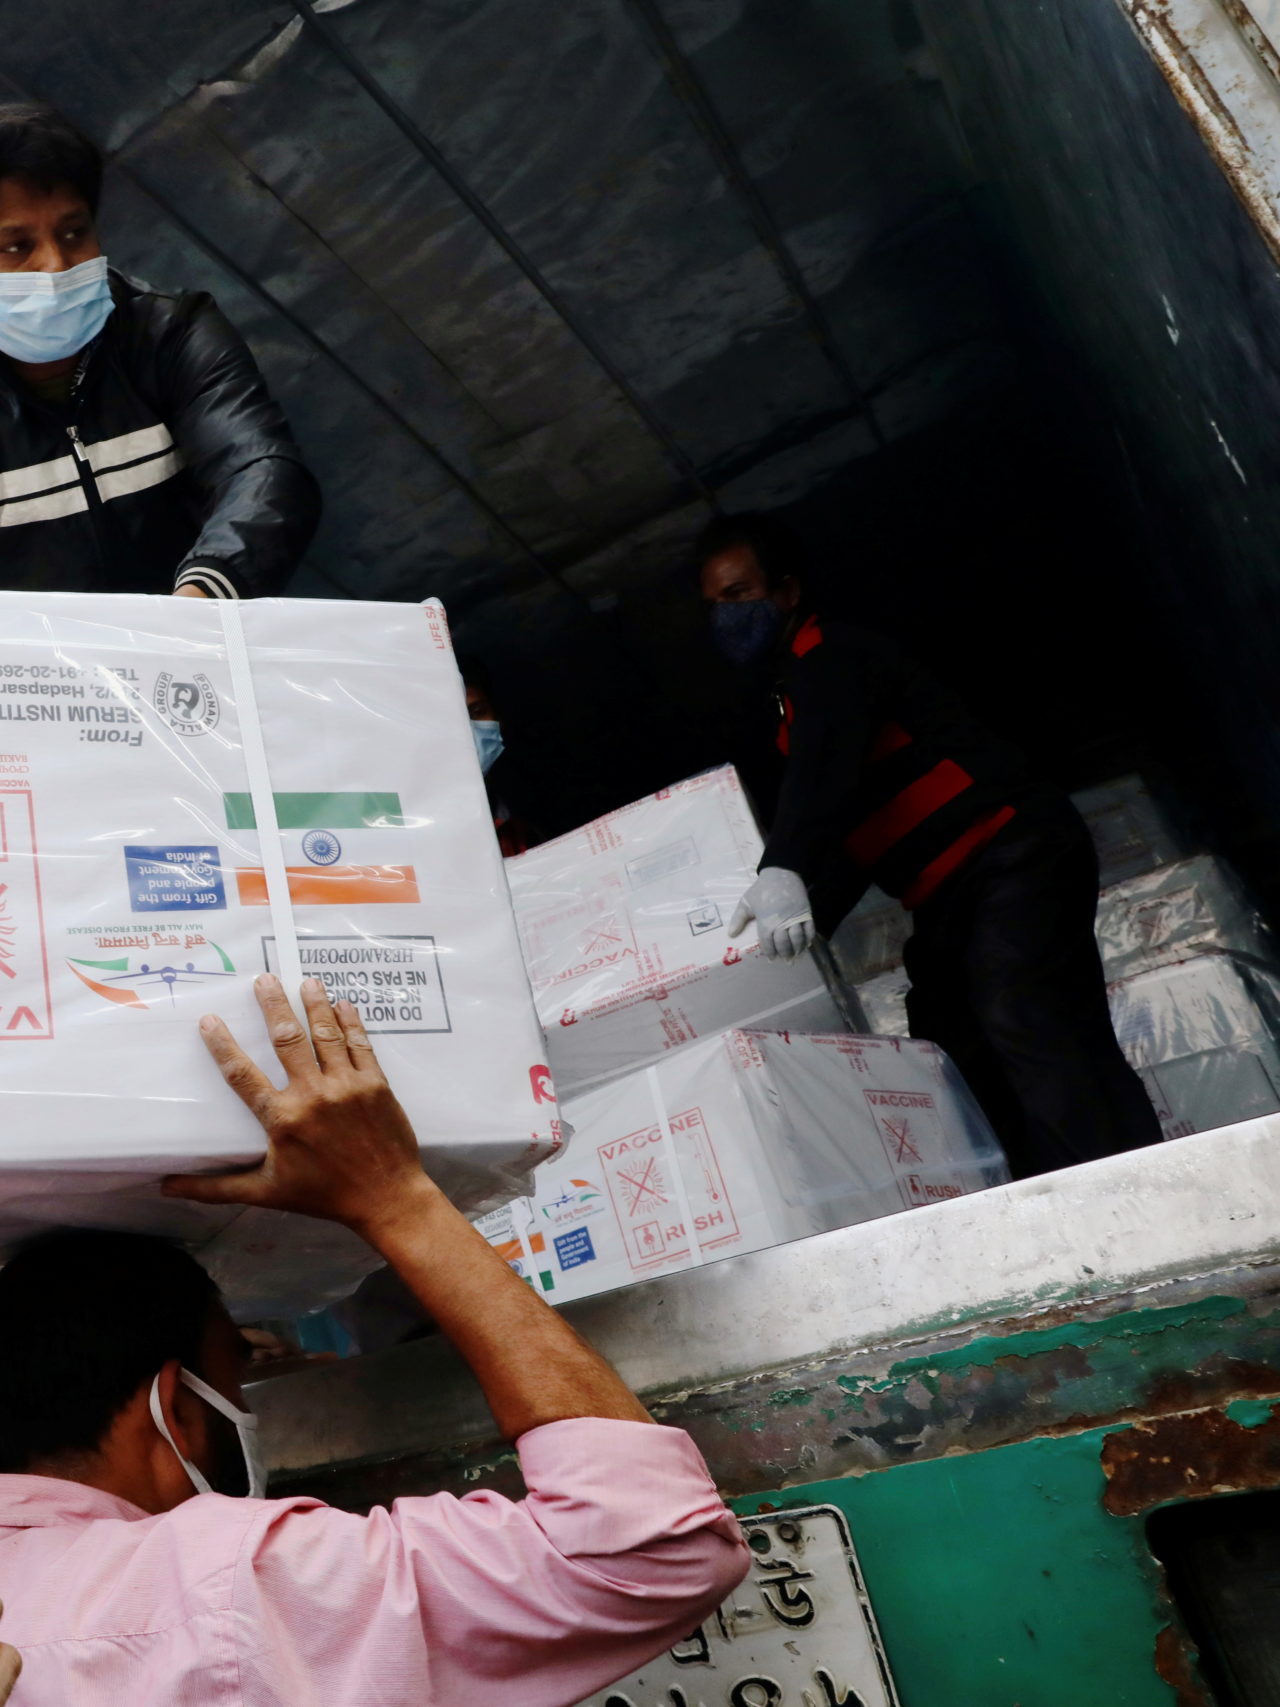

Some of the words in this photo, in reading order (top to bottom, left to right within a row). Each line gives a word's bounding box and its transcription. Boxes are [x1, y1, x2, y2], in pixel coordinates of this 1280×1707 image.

[156, 673, 170, 714] GROUP
[69, 705, 143, 723] SERUM
[80, 729, 144, 747] From:
[166, 852, 194, 863] India
[148, 879, 172, 890] and
[138, 893, 160, 904] the
[160, 893, 191, 904] from
[194, 892, 218, 904] Gift
[66, 926, 103, 935] DISEASE
[104, 925, 131, 934] FROM
[131, 925, 153, 933] FREE
[154, 925, 166, 933] BE
[166, 924, 183, 932] ALL
[184, 923, 204, 931] MAY
[374, 971, 402, 986] PAS
[406, 971, 428, 985] NE
[365, 1006, 395, 1022] NOT
[400, 1006, 422, 1021] DO
[866, 1094, 933, 1109] VACCINE
[602, 1112, 701, 1160] VACCNE
[925, 1184, 962, 1199] RUSH
